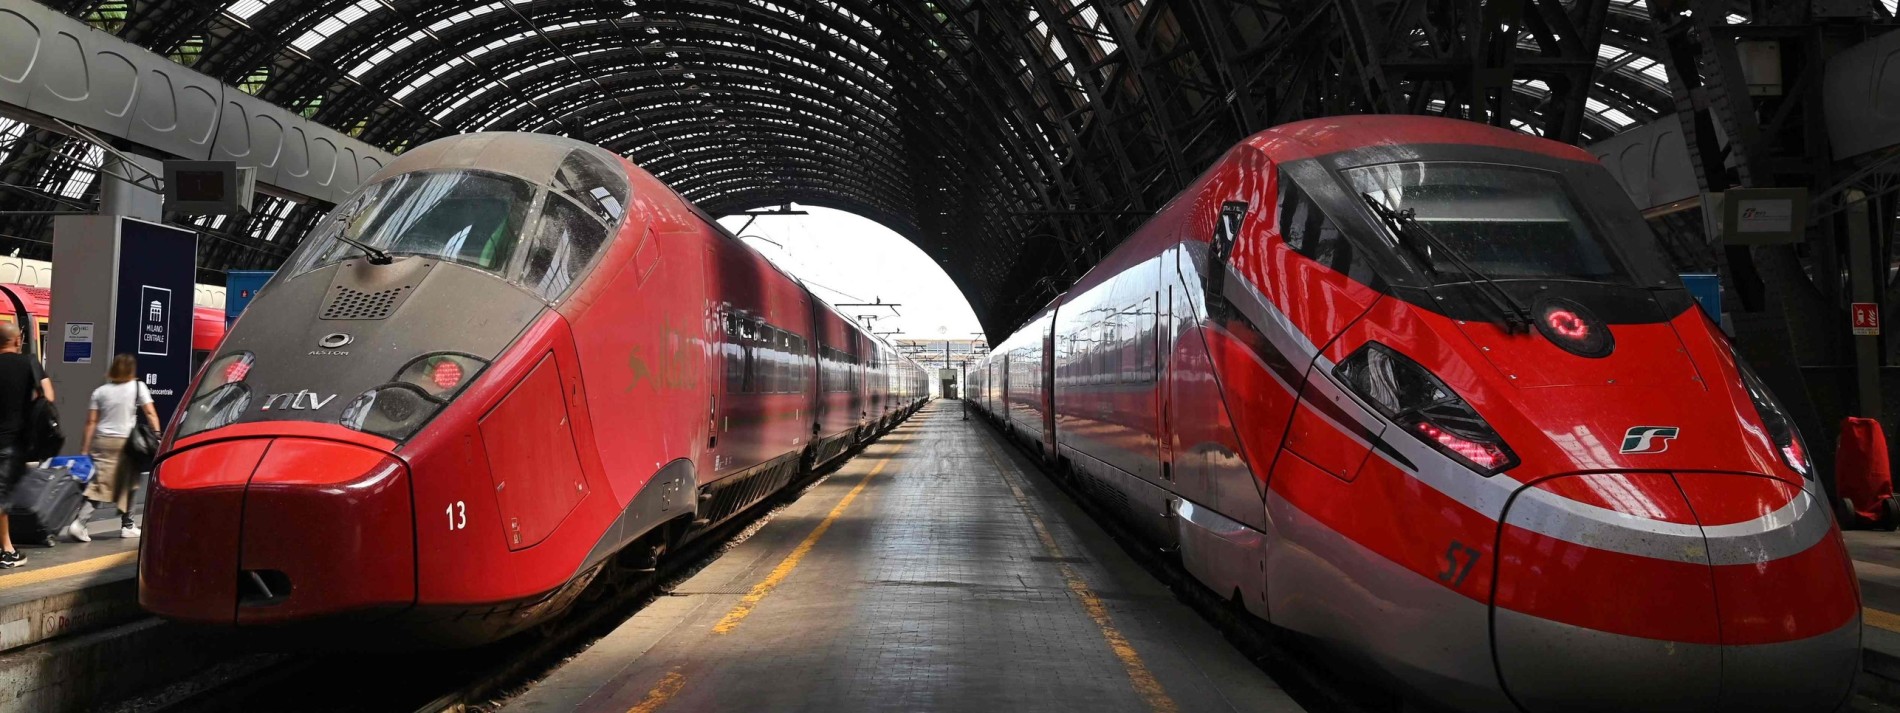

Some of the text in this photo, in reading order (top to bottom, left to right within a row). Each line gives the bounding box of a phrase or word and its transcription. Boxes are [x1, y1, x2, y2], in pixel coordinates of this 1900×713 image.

[146, 324, 163, 333] MILANO
[143, 333, 165, 343] CENTRALE
[260, 388, 338, 411] ntv
[446, 500, 466, 531] 13
[1439, 541, 1480, 587] 57
[58, 615, 70, 629] Do
